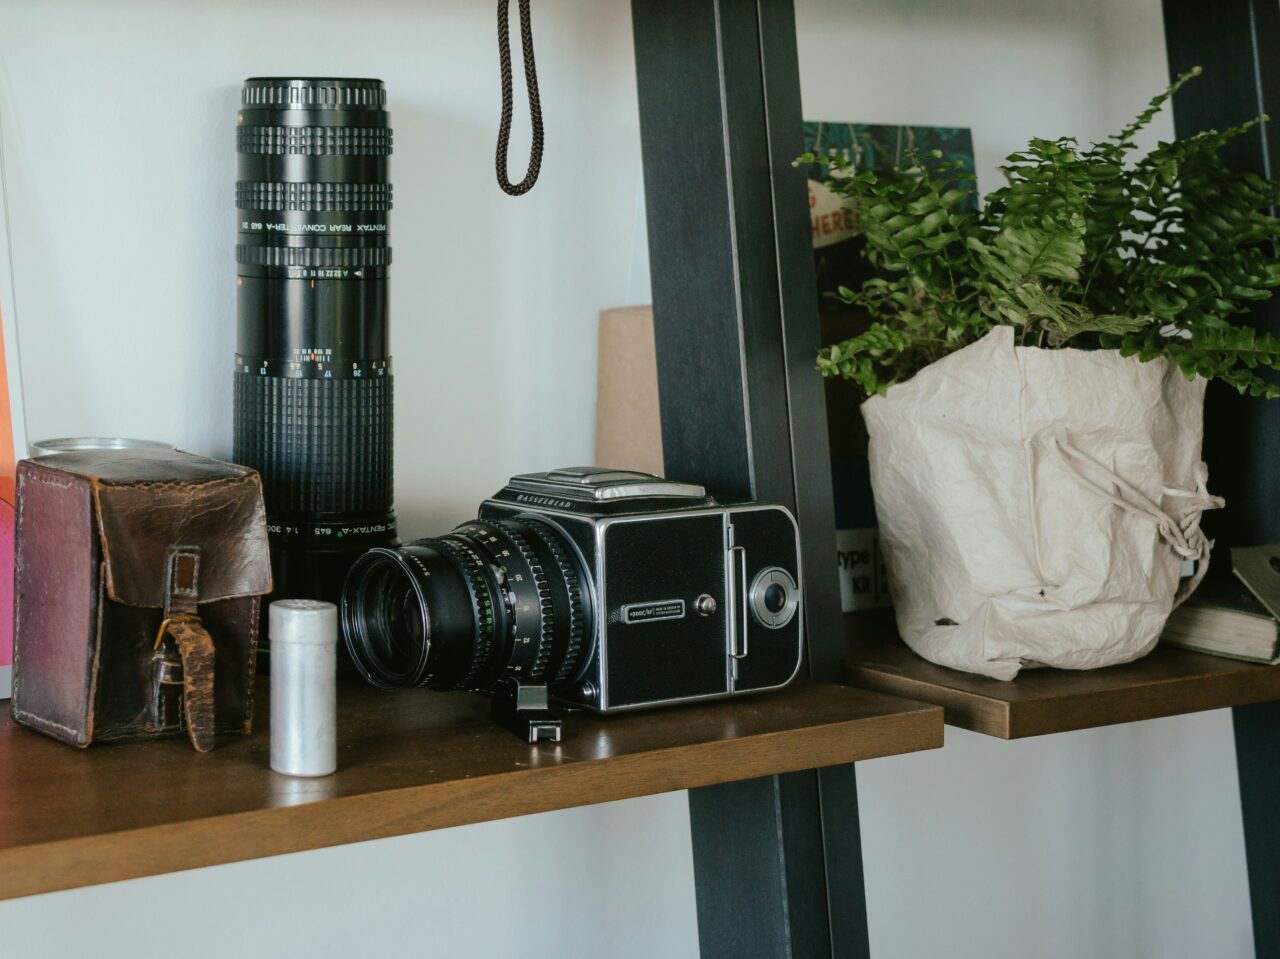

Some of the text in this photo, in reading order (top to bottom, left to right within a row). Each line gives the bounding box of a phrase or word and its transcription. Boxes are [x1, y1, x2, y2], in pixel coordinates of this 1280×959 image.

[329, 224, 352, 232] REAR
[517, 495, 571, 508] HASSELBLAD
[314, 527, 331, 535] 645
[341, 525, 386, 534] PENTAX-A
